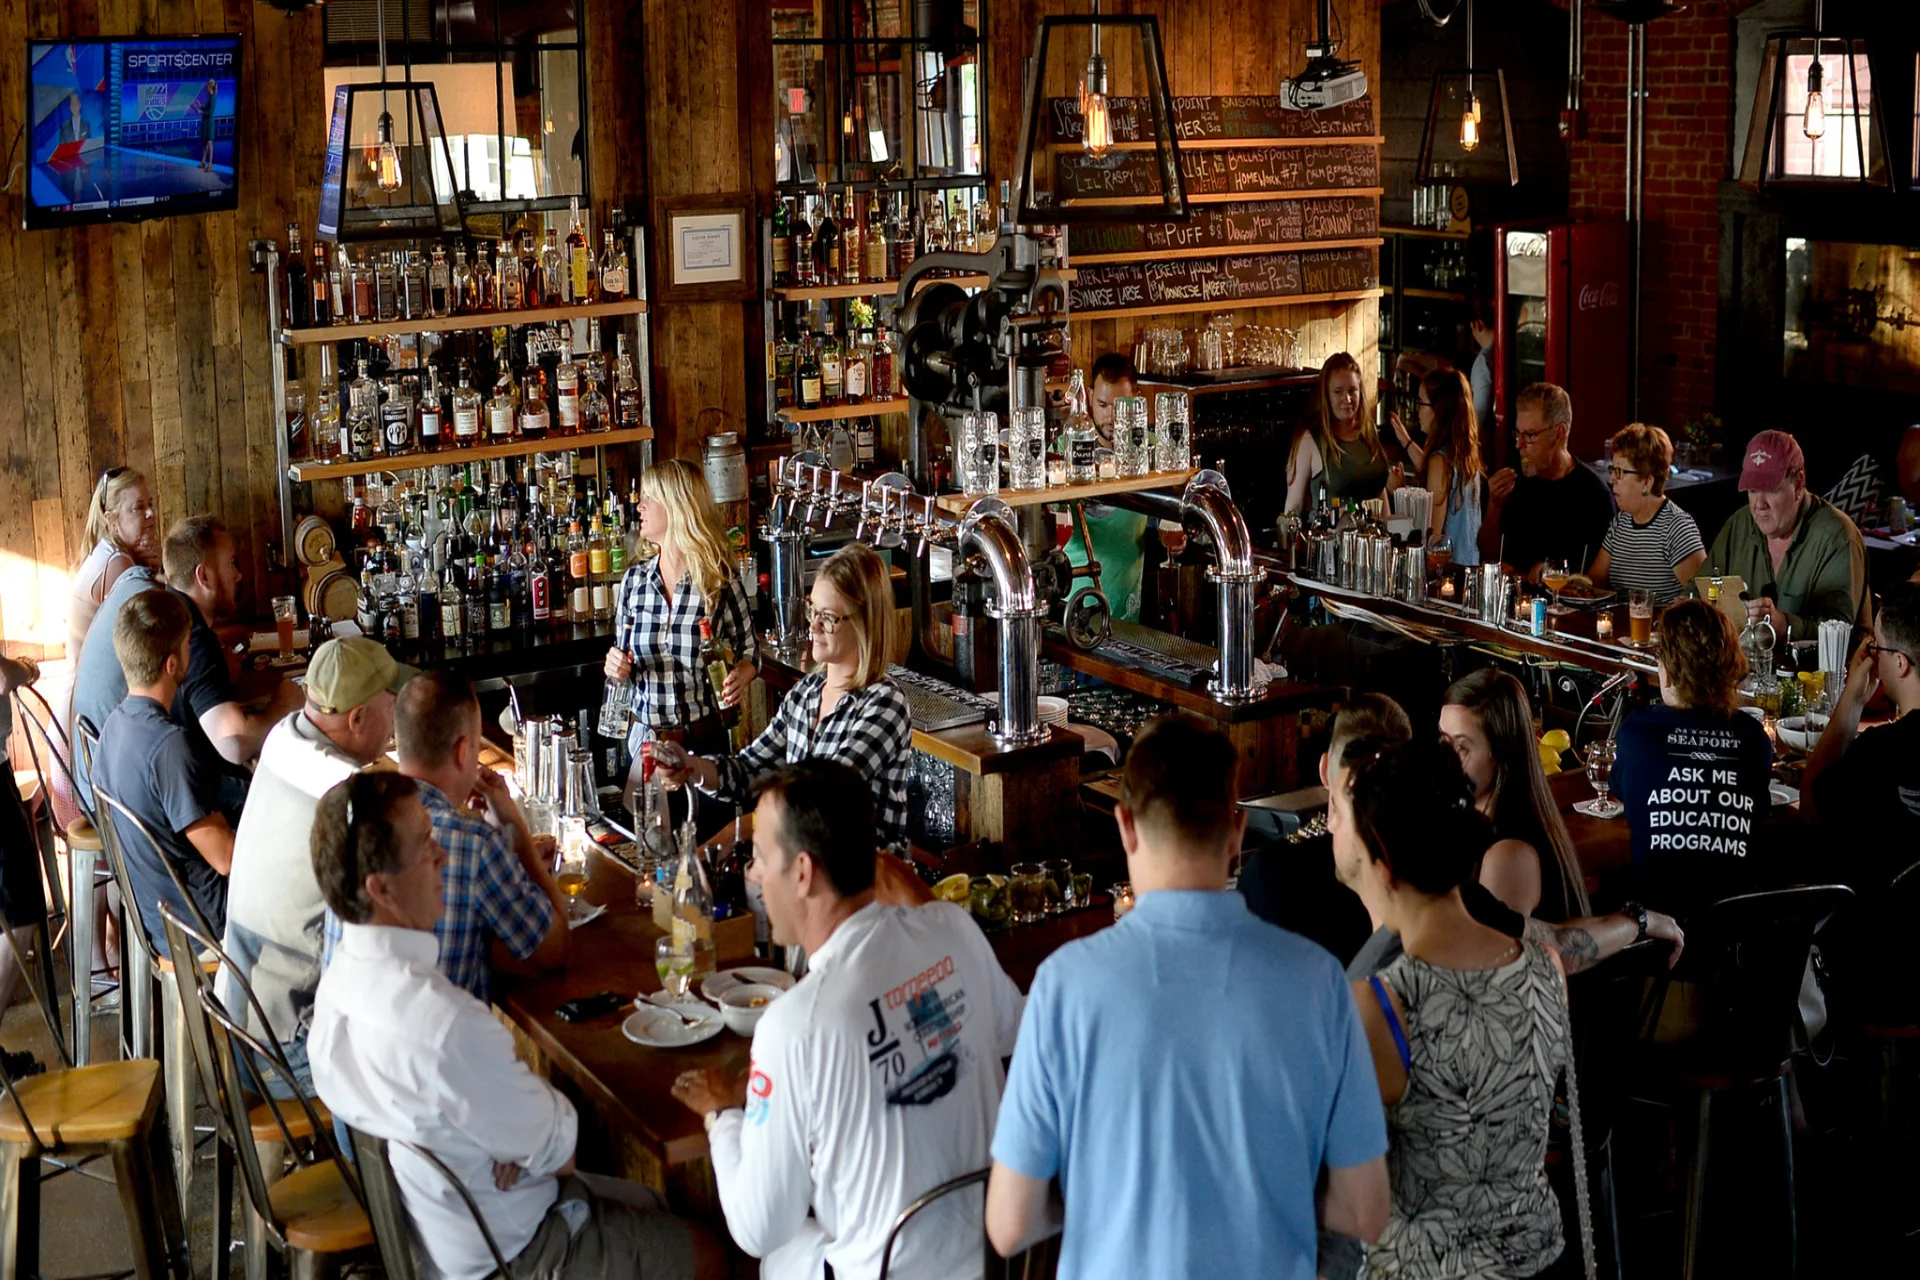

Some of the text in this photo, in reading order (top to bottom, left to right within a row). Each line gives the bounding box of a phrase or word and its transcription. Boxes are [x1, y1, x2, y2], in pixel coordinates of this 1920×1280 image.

[128, 53, 233, 68] SPORTSCENTER
[1222, 97, 1260, 108] SAISON
[1311, 109, 1363, 134] SEXTANT
[1228, 149, 1268, 171] BALLAST
[1269, 148, 1300, 174] POINT
[1304, 147, 1345, 167] BALLAST
[1104, 169, 1134, 192] RASPY
[1302, 199, 1345, 223] BALLAST
[1347, 198, 1376, 223] POINT
[1164, 222, 1203, 247] PUFF
[1313, 213, 1352, 238] GRUNION
[1100, 266, 1129, 283] LIGHT
[1224, 256, 1253, 279] CONEY
[1233, 266, 1297, 297] MERMAID PILS
[1117, 284, 1143, 305] LAPSE
[1667, 733, 1741, 749] SEAPORT
[1667, 766, 1737, 786] ASK ME
[1647, 788, 1754, 813] ABOUT OUR
[1649, 810, 1750, 834] EDUCATION
[1650, 834, 1747, 858] PROGRAMS
[868, 998, 886, 1047] J
[877, 1051, 905, 1085] 70
